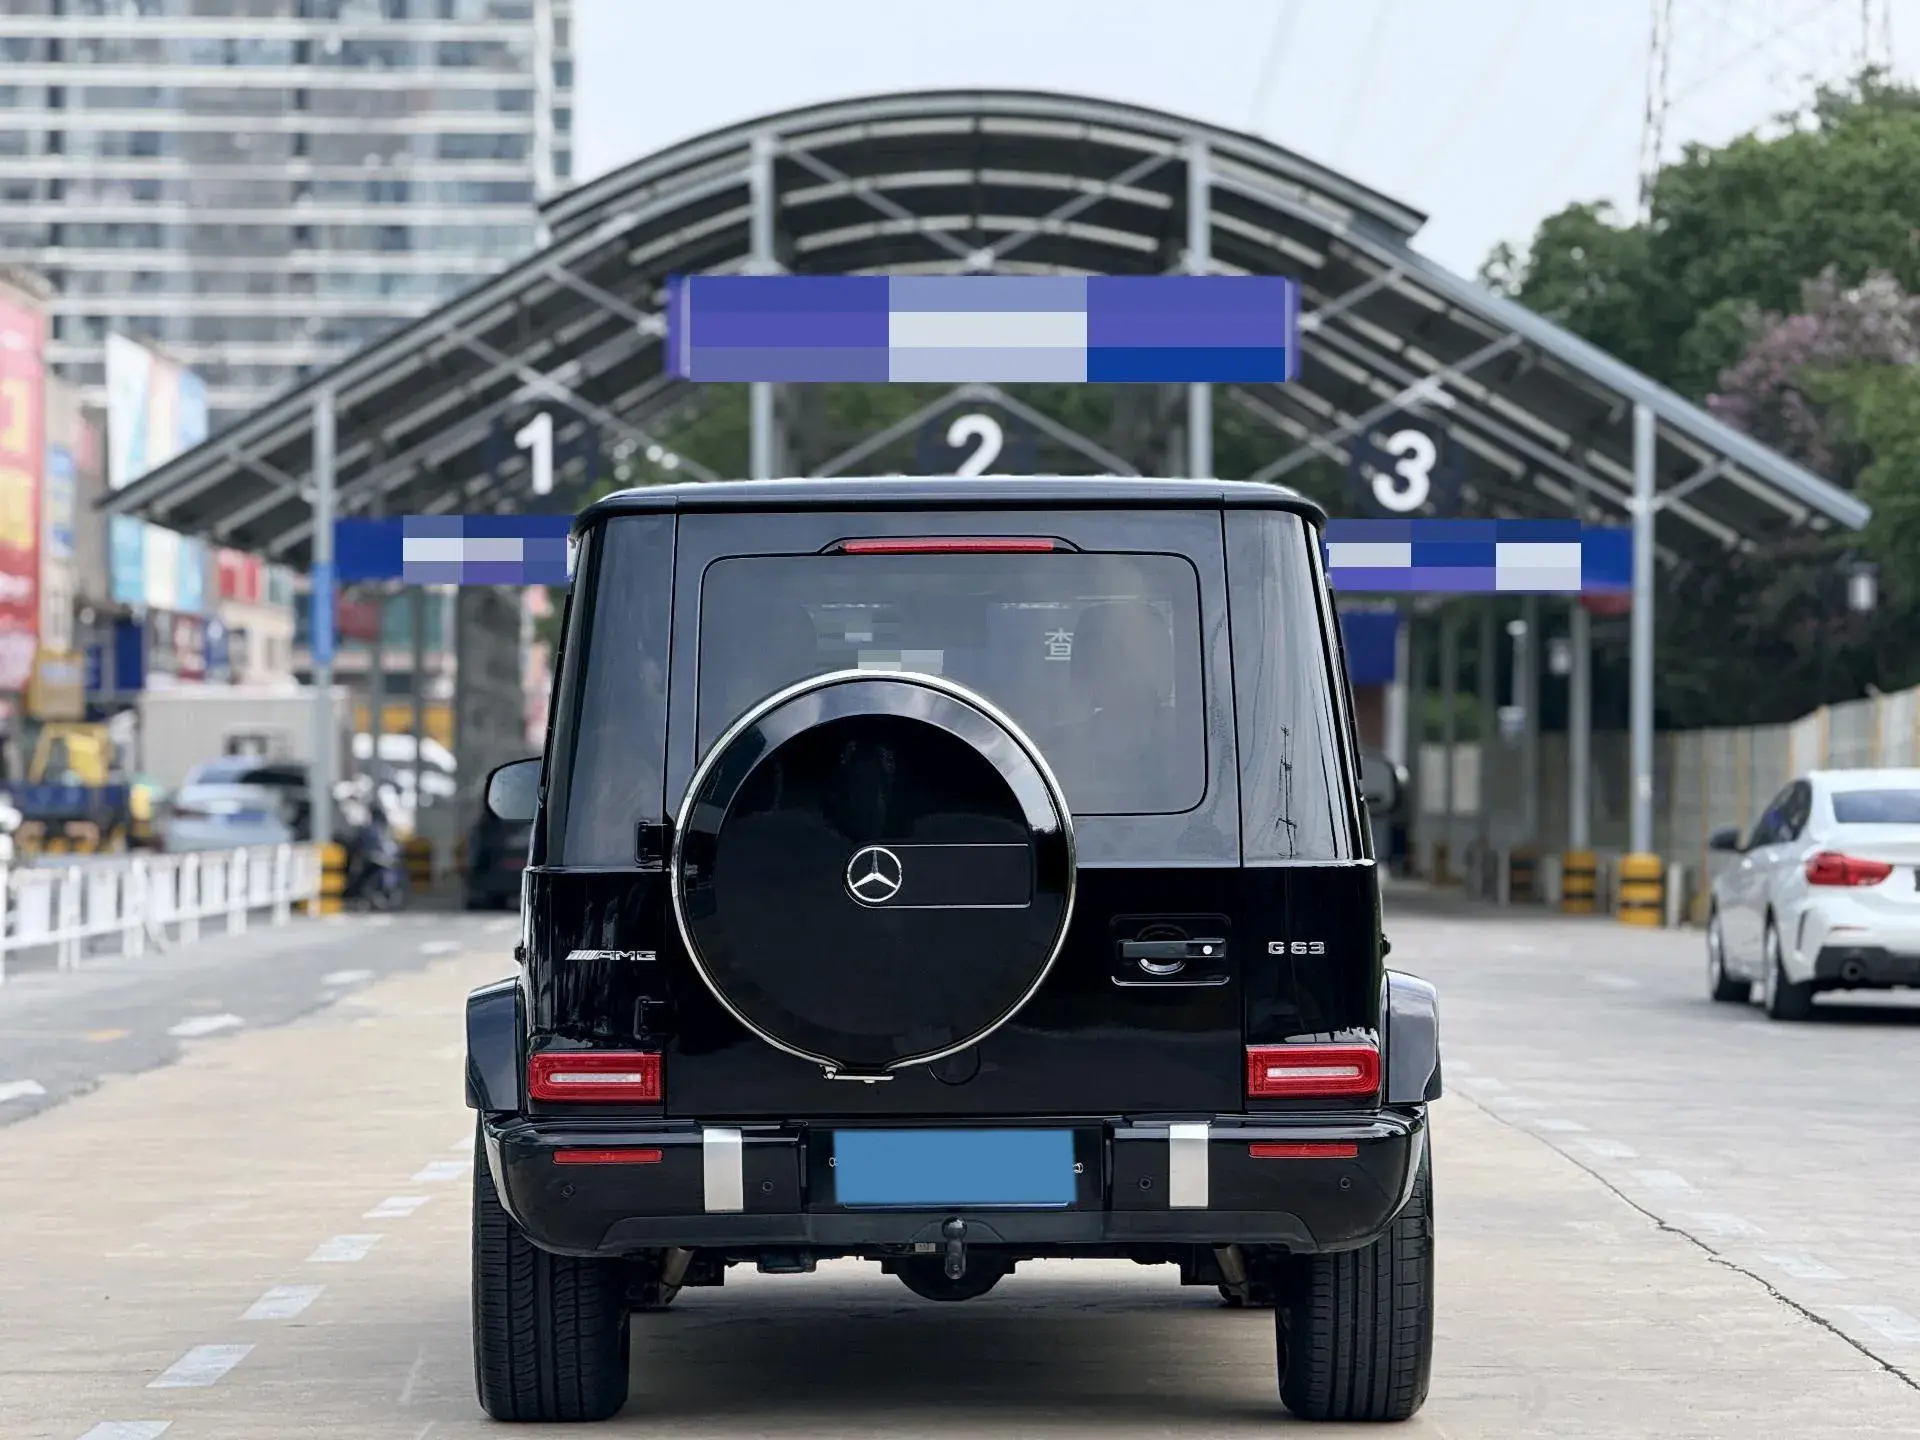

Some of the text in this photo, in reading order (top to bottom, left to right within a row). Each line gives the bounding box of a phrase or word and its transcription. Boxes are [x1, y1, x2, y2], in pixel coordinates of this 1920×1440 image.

[514, 411, 553, 495] 1
[946, 413, 1003, 477] 2
[1372, 429, 1436, 512] 3
[1044, 627, 1074, 661] 查
[597, 949, 656, 960] AMG
[1268, 941, 1325, 954] G 63
